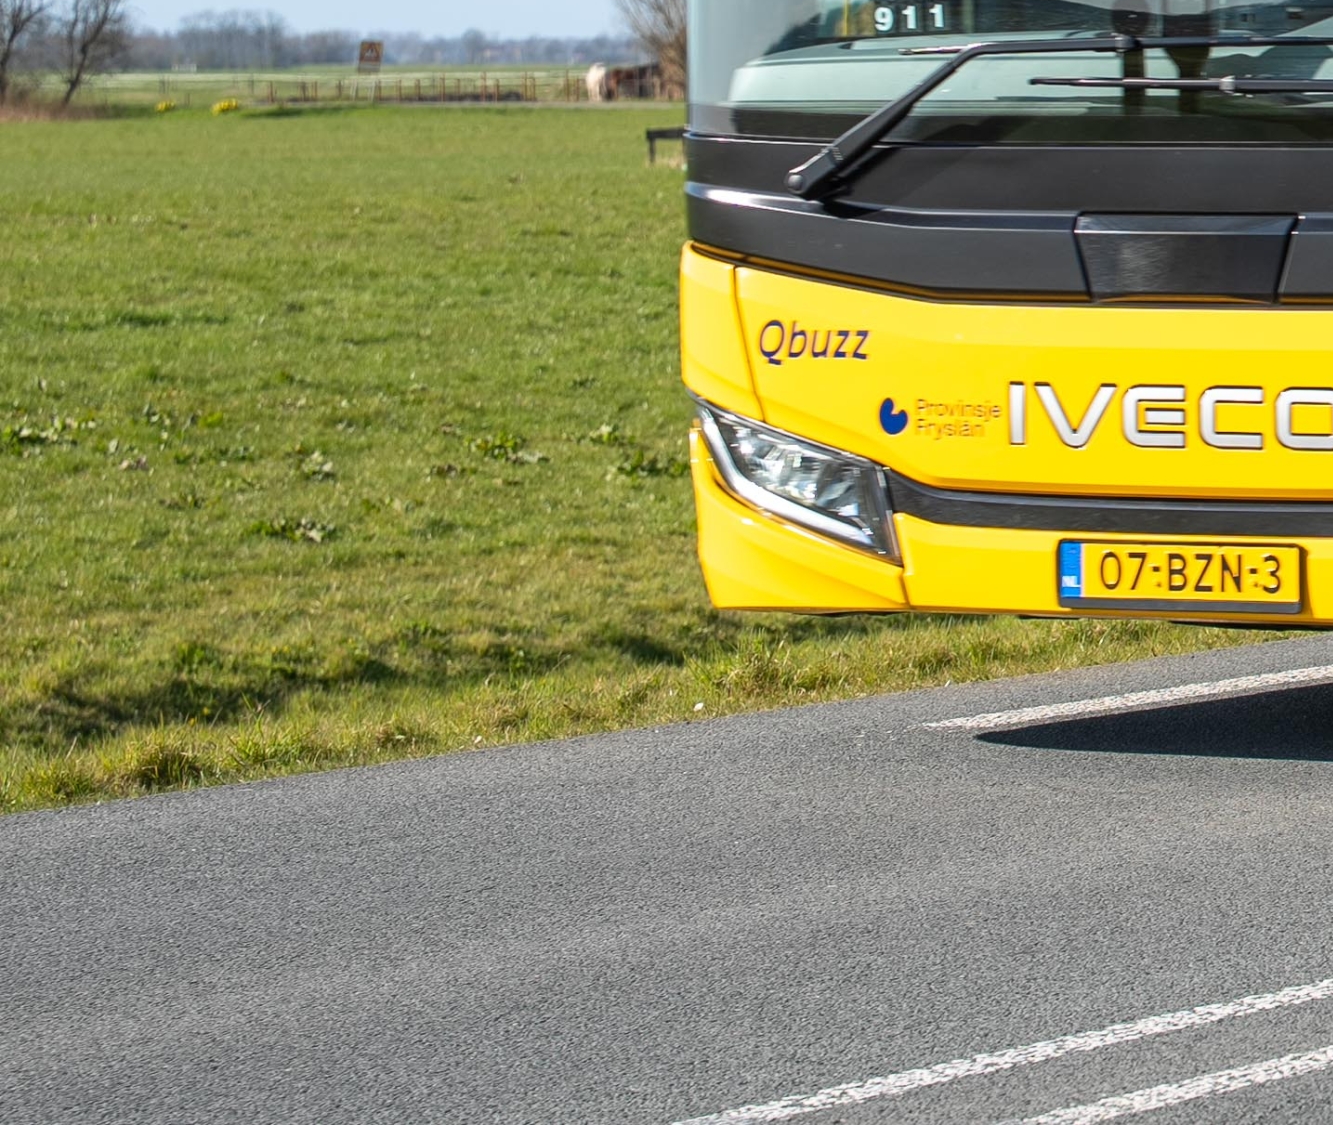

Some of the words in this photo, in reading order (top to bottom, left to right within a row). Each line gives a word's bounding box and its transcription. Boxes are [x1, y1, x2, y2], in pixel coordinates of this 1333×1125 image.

[873, 3, 945, 32] 911
[759, 319, 871, 366] Qbuzz
[915, 398, 1002, 422] Provinsje
[1100, 551, 1281, 594] 07-BZN-3
